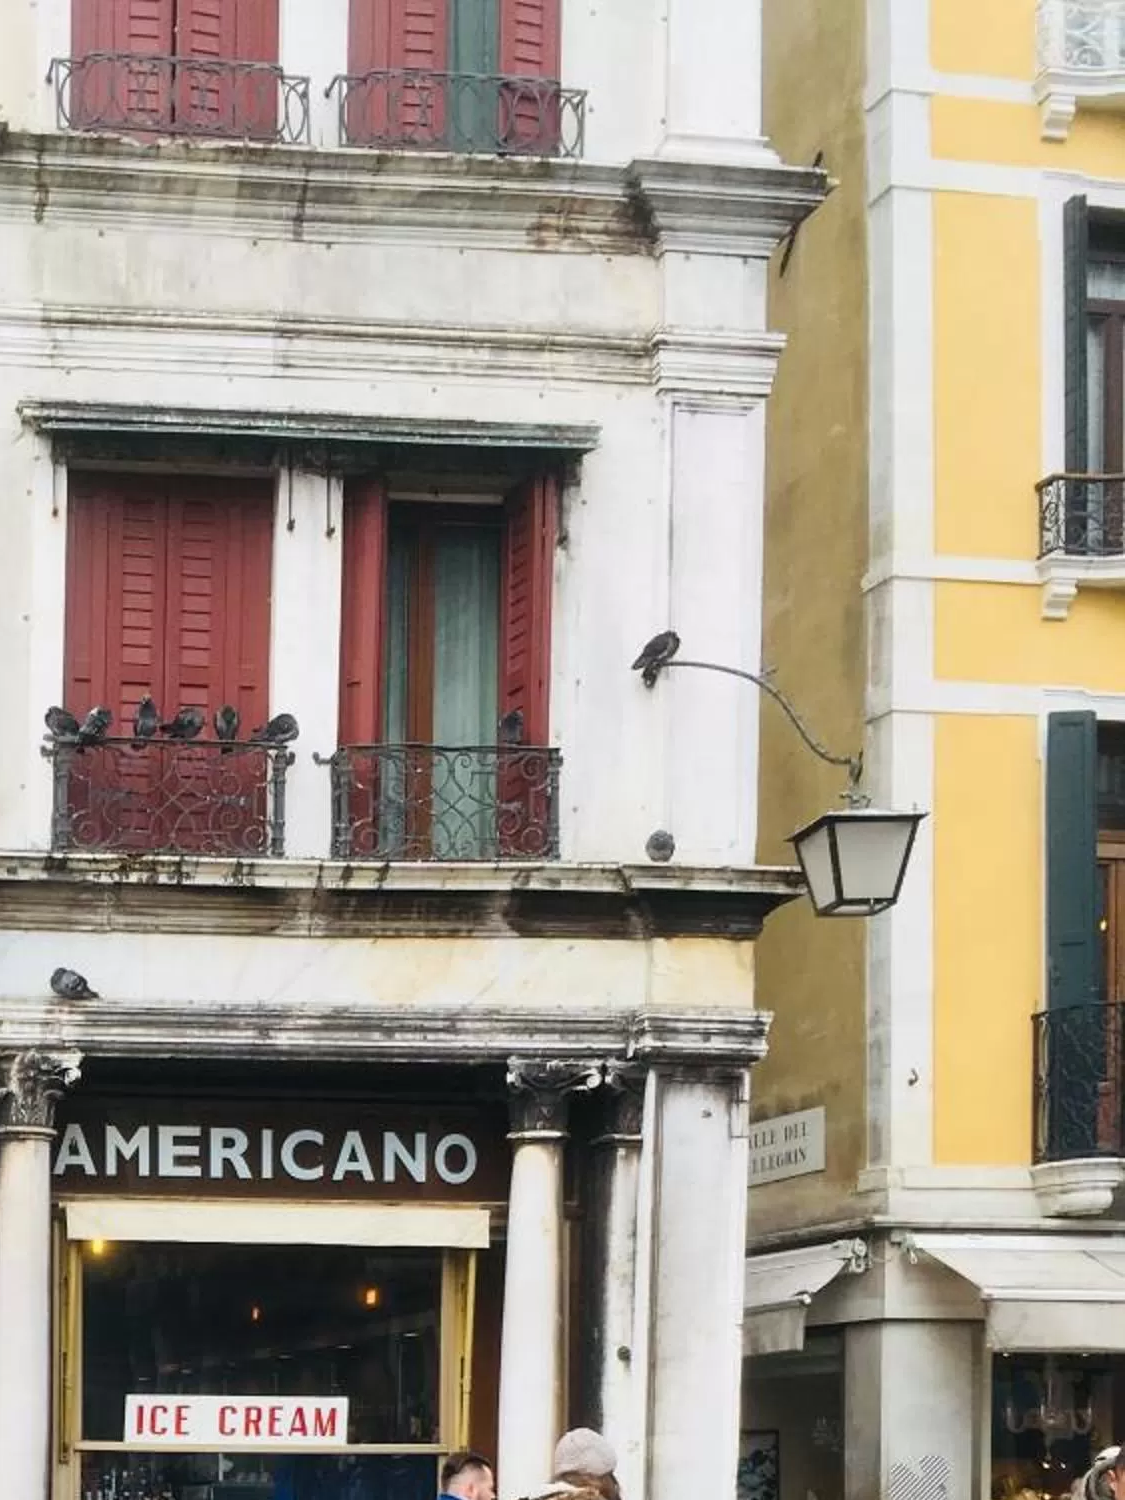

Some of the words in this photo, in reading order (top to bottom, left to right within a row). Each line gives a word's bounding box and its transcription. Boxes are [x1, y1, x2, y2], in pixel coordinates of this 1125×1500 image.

[53, 1123, 478, 1185] AMERICANO
[135, 1405, 191, 1436] ICE
[218, 1405, 338, 1437] CREAM
